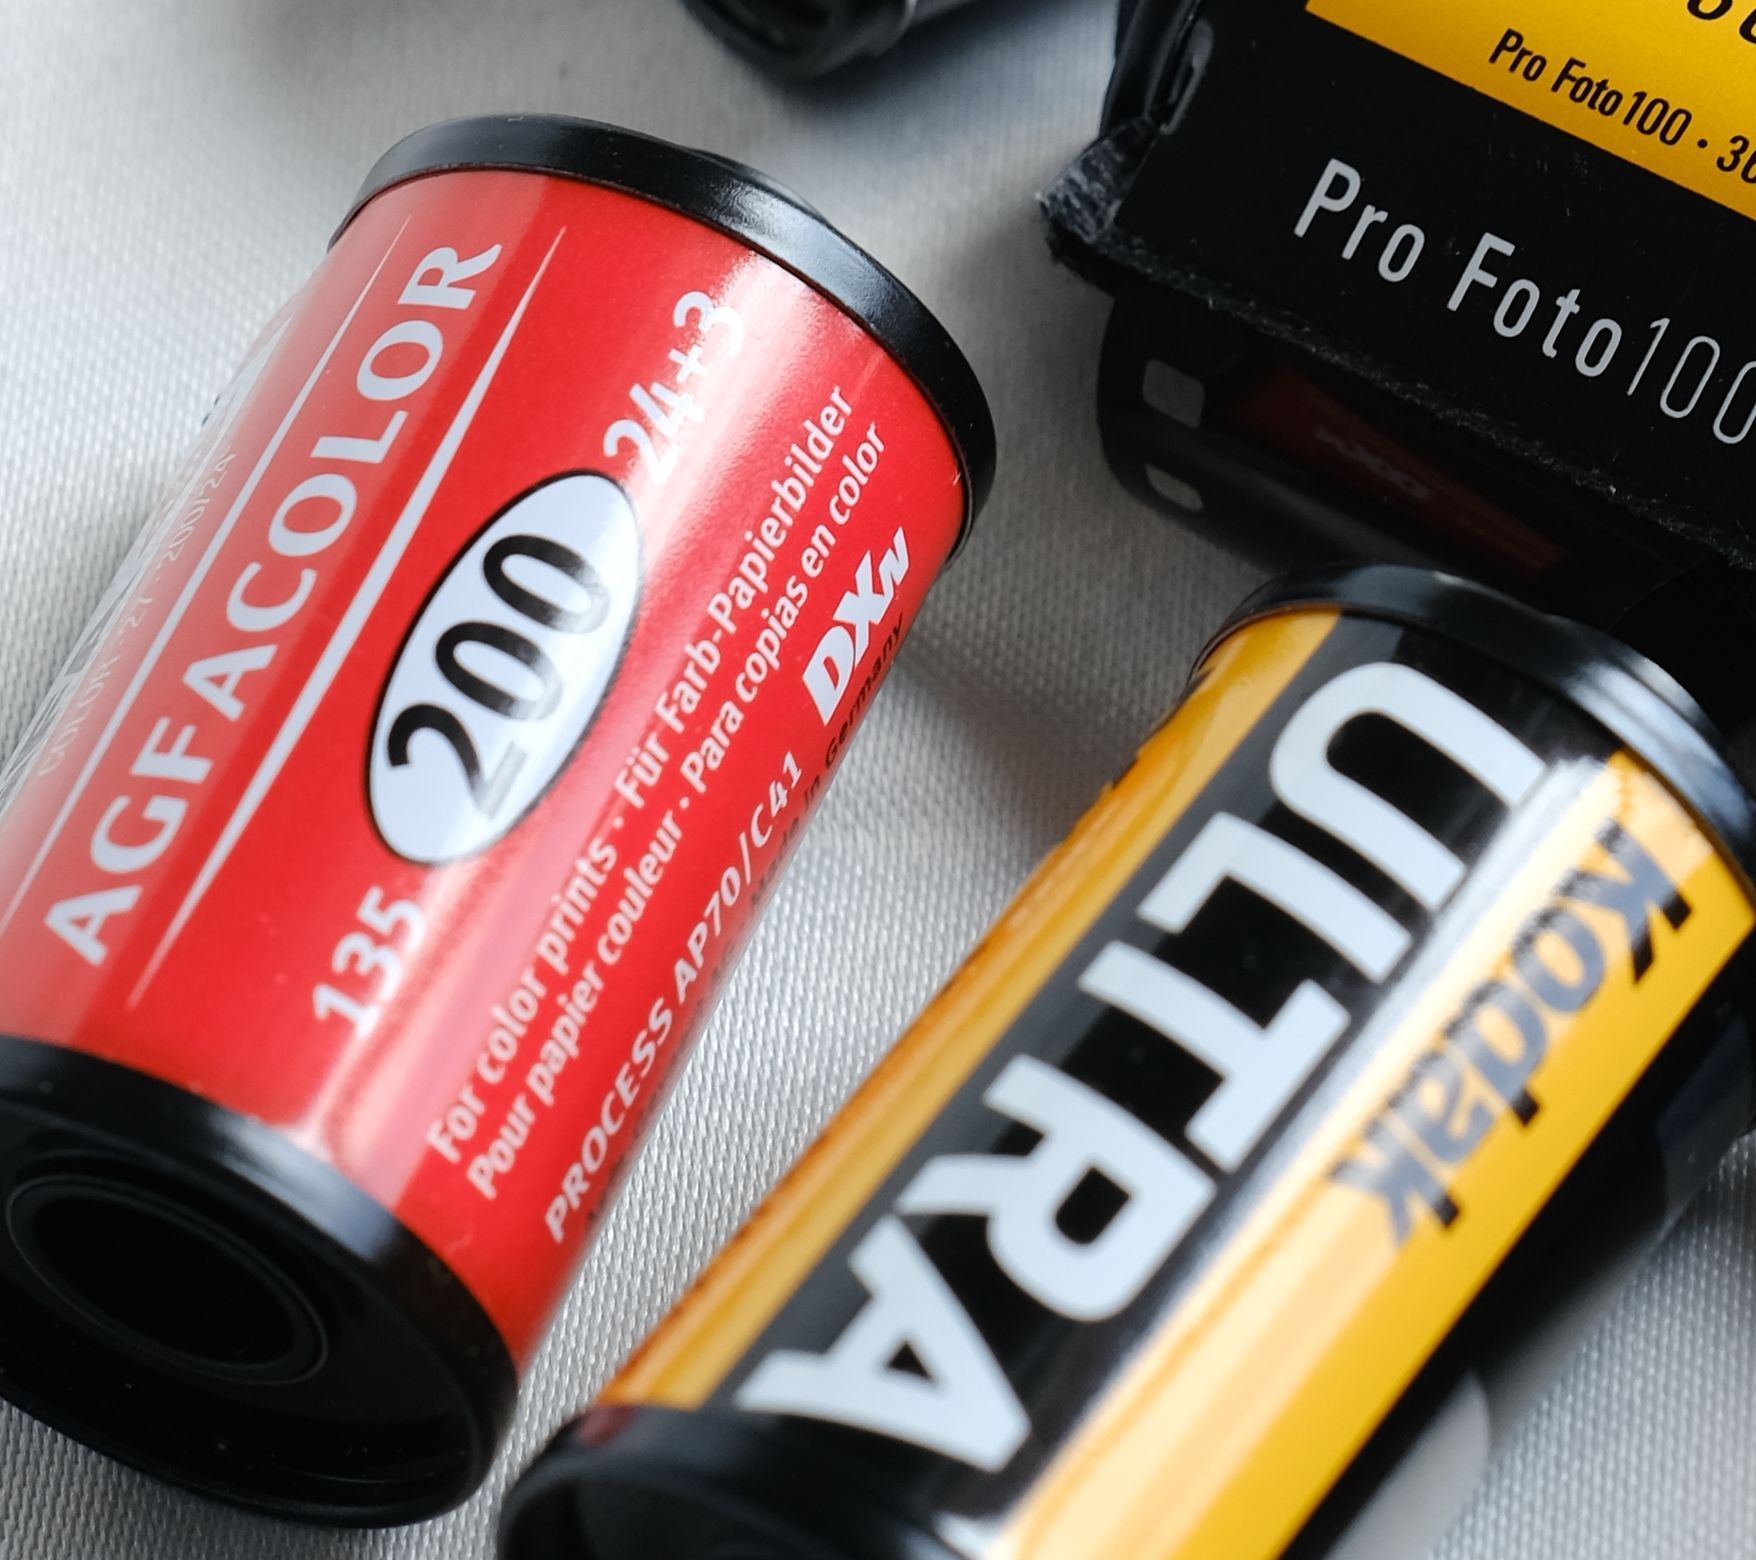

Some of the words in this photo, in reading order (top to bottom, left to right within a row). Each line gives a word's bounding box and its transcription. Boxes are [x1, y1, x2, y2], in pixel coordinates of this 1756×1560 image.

[1295, 159, 1425, 282] Pro
[1489, 29, 1547, 82] Pro
[1551, 58, 1692, 146] Foto100
[44, 244, 502, 965] AGFACOLOR
[604, 292, 746, 489] 24+3
[386, 532, 612, 816] 200
[425, 1078, 485, 1162] For
[476, 962, 547, 1085] color
[536, 837, 618, 976] prints
[614, 722, 671, 808] Für
[652, 386, 853, 734] Farb-Papierbilder
[467, 1093, 540, 1199] Pour
[527, 962, 605, 1102] papier
[597, 820, 684, 965] couleur
[680, 702, 743, 794] Para
[736, 576, 808, 702] copias
[801, 525, 835, 577] en
[830, 423, 884, 524] color
[314, 887, 427, 1042] 135
[545, 997, 672, 1241] PROCESS
[675, 752, 801, 1002] AP70/C41
[740, 659, 1555, 1474] ULTRA
[1321, 815, 1694, 1249] Kodak
